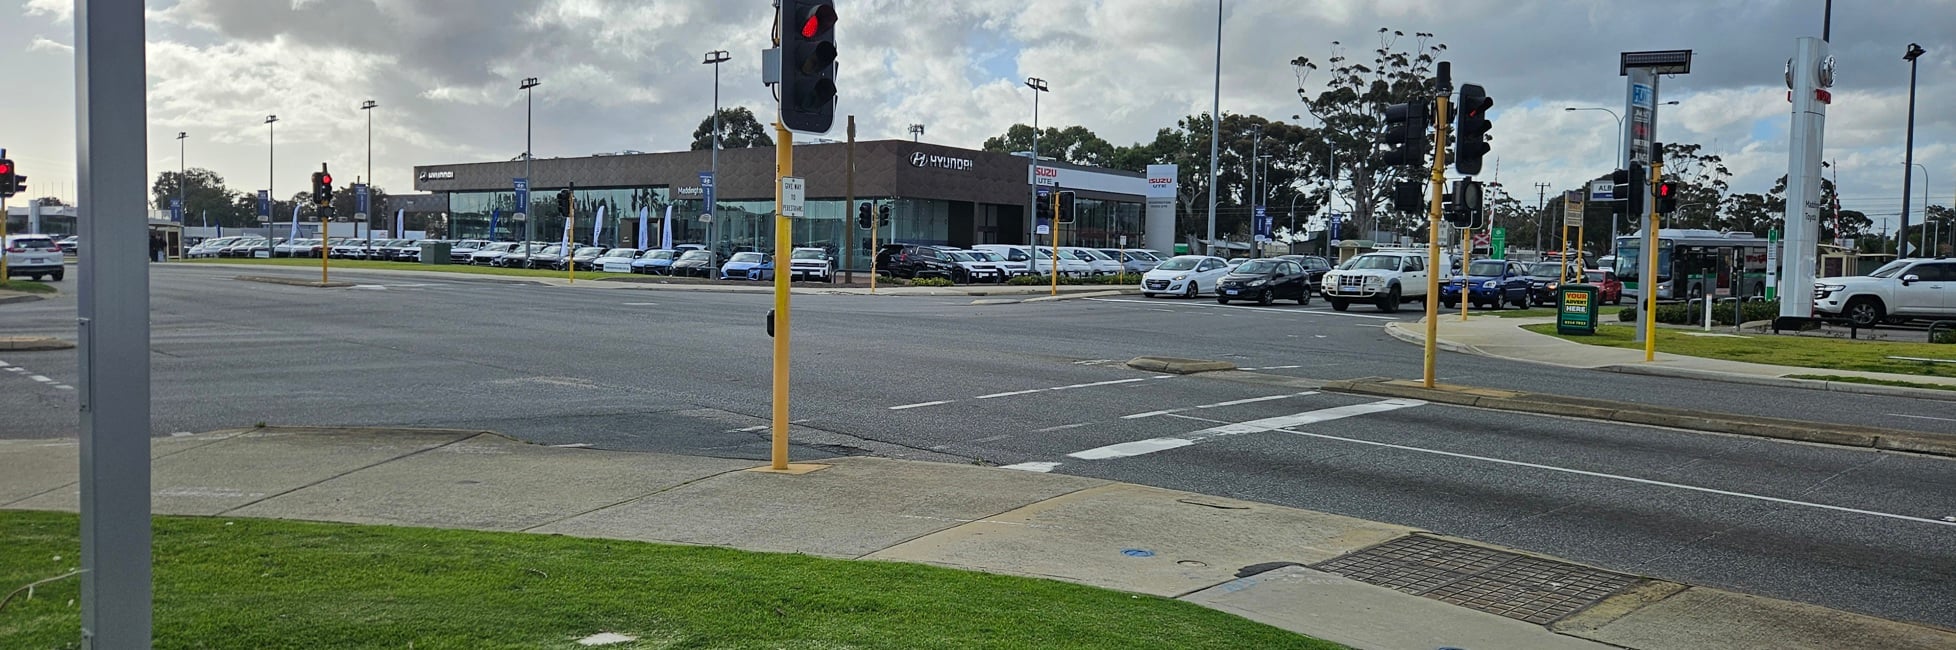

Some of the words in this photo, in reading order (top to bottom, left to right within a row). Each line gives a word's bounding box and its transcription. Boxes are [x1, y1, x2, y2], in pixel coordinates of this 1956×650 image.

[930, 155, 972, 170] HYUNDAI
[1035, 167, 1057, 177] SUZU
[677, 186, 704, 195] Maddingto
[785, 182, 793, 190] GIVE
